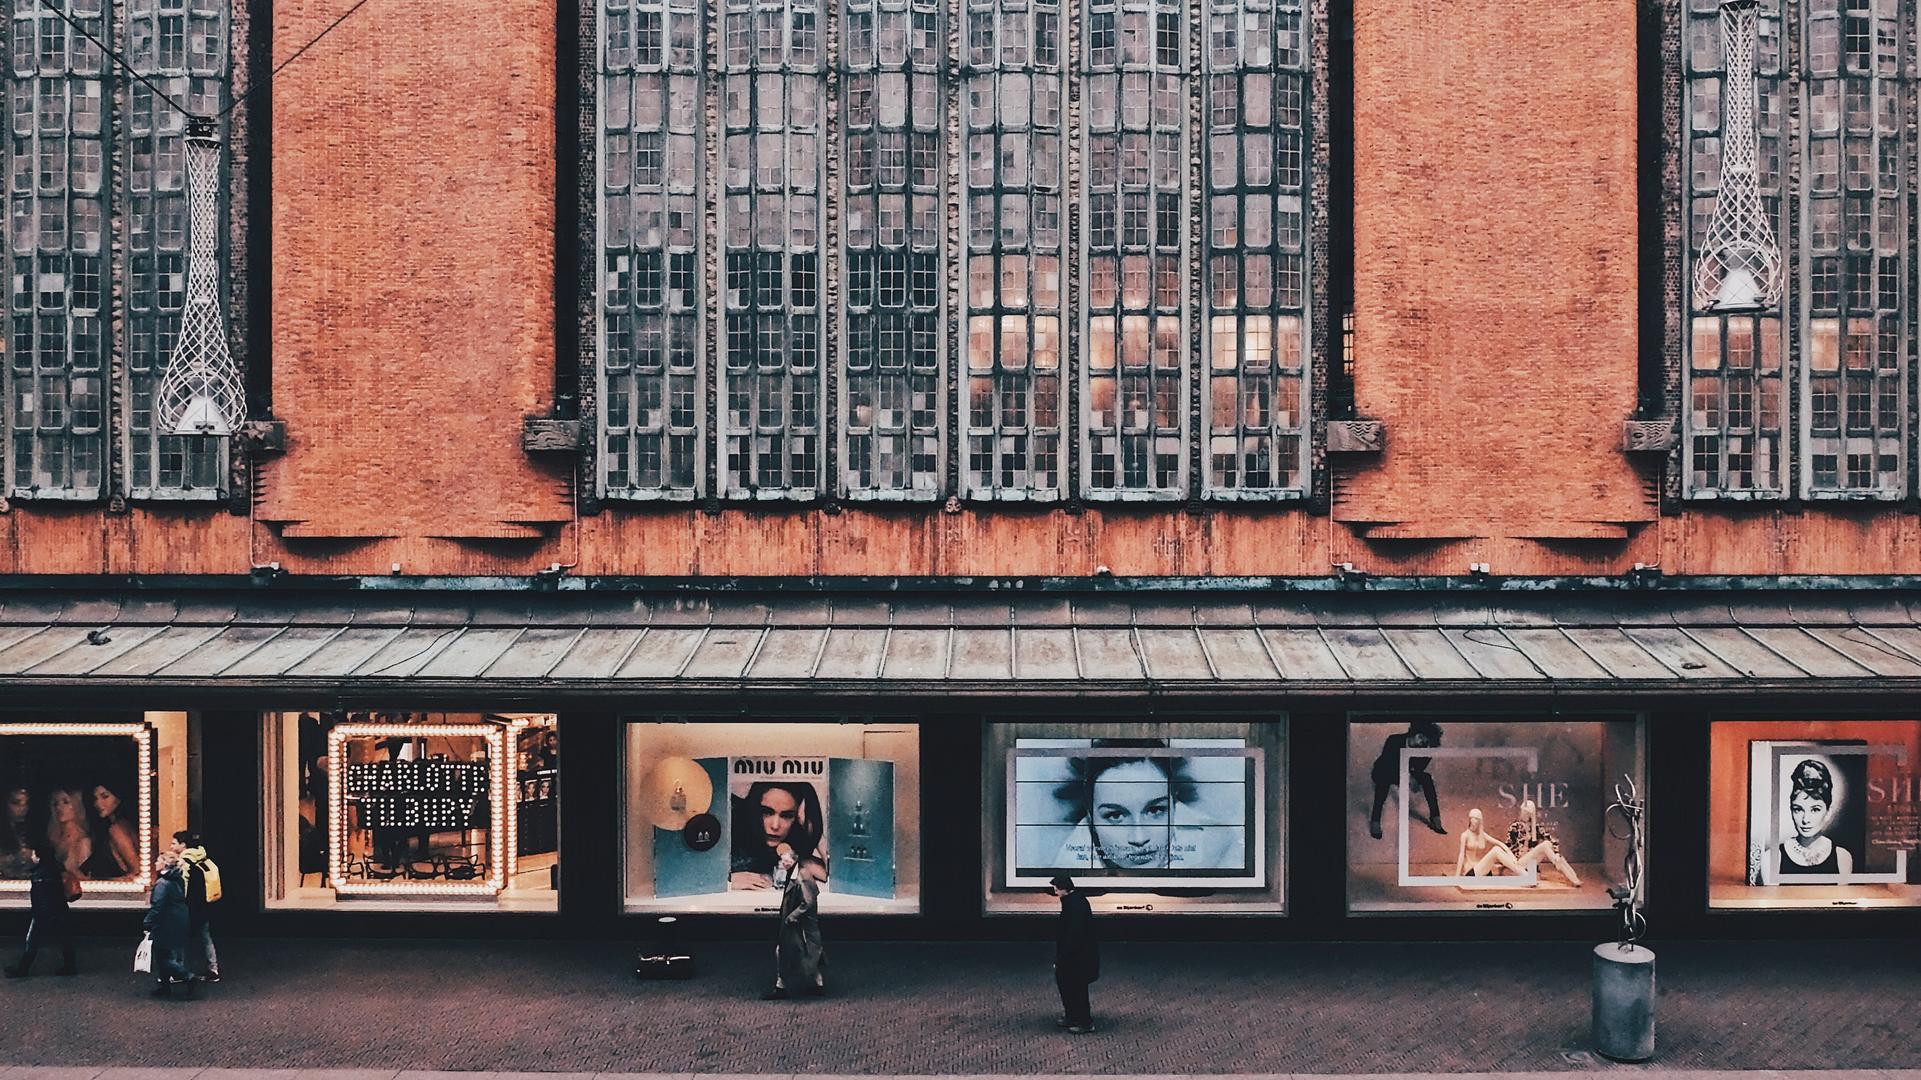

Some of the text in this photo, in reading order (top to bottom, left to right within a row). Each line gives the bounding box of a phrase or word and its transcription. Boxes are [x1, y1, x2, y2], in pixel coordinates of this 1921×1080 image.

[348, 763, 485, 792] CHARLOTTE
[734, 760, 823, 775] MIU MIU
[1497, 782, 1569, 808] SHE
[1867, 777, 1921, 802] SH
[360, 797, 474, 827] TILBURY
